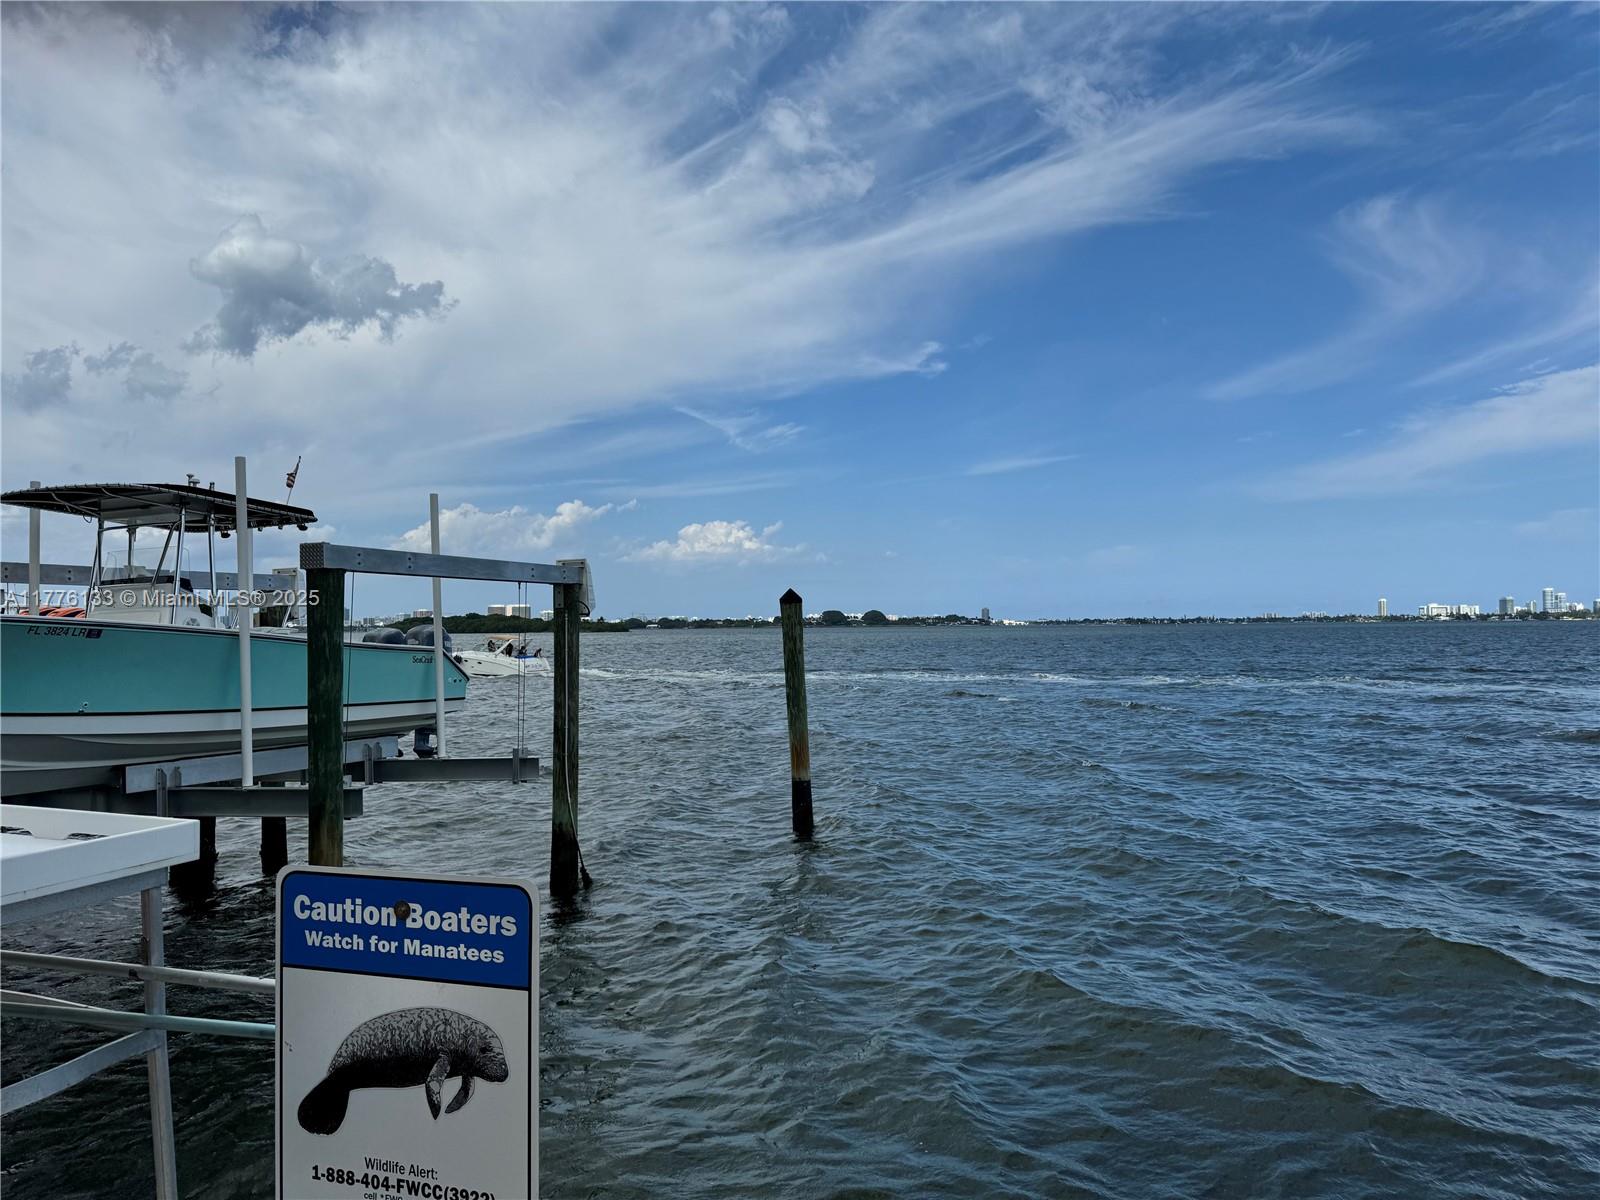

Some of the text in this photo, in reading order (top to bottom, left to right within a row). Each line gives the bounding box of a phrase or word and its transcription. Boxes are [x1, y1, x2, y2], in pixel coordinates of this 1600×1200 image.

[27, 625, 41, 635] FL
[44, 626, 69, 637] 3824
[71, 628, 87, 638] LR
[293, 894, 518, 937] Caution Boaters
[304, 929, 505, 964] Watch for Manatees
[364, 1156, 438, 1181] Wildlife Alert:
